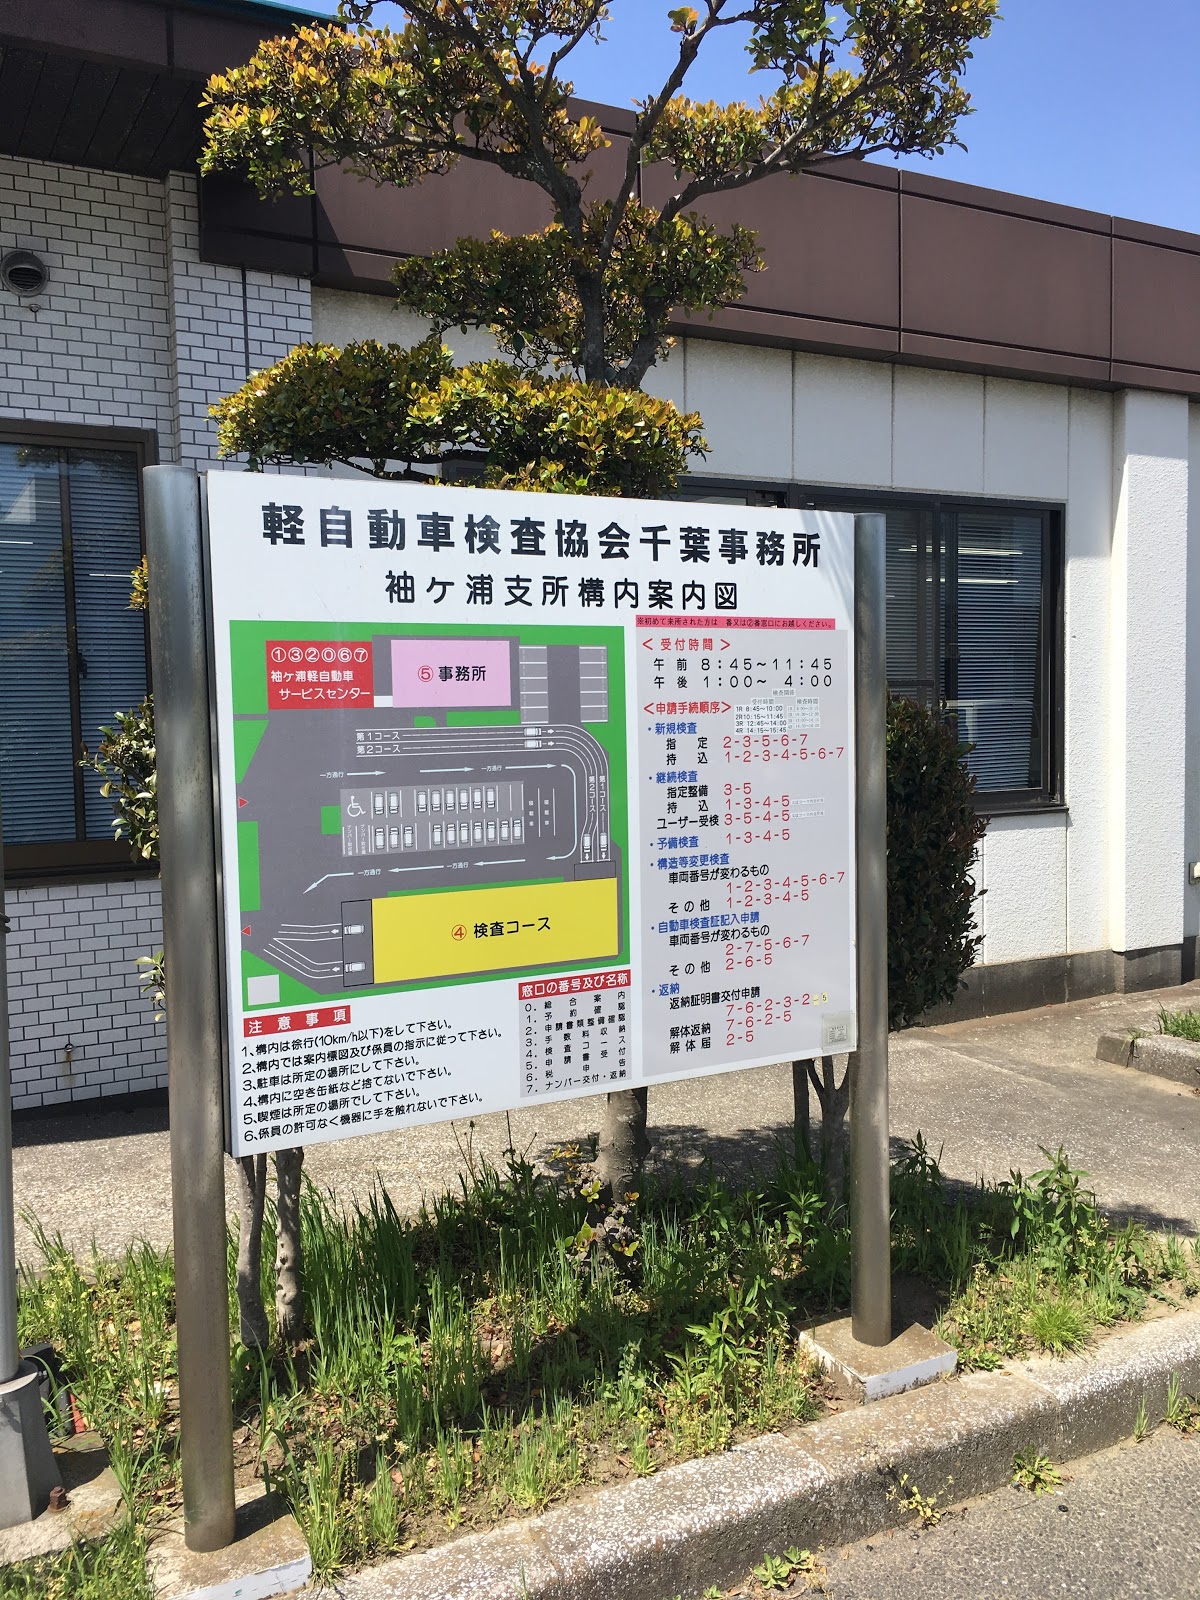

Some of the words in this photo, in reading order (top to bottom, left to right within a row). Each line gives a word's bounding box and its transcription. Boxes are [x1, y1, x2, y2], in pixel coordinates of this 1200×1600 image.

[261, 501, 822, 568] 軽自動車検査協会千葉事務所
[439, 666, 486, 681] 事務所
[654, 658, 688, 670] 午前
[654, 676, 688, 688] 午後
[279, 688, 370, 700] サービスセンター
[356, 731, 401, 742] 第1コース
[356, 743, 401, 754] 第2コース
[726, 747, 844, 763] 1-2-3-4-5-6-7
[667, 785, 708, 798] 指定整備
[724, 783, 751, 795] 3-5
[726, 796, 790, 810] 1-3-4-5
[657, 815, 719, 829] ユーザー受検
[724, 810, 790, 825] 3-5-4-5
[727, 829, 790, 844] 1-3-4-5
[668, 864, 769, 884] 車両番号が変わるもの
[726, 872, 845, 893] 1-2-3-4-5-6-7
[668, 899, 710, 914] その他
[726, 890, 809, 908] 1-2-3-4-5
[474, 916, 551, 938] 検査コース
[669, 925, 769, 946] 車両番号が変わるもの
[725, 935, 809, 955] 2-7-5-6-7
[669, 961, 711, 976] その他
[726, 953, 772, 970] 2-6-5
[522, 973, 628, 997] 窓口の番号及び名称
[670, 987, 760, 1010] 返納証明書交付申請
[249, 1009, 346, 1034] 注意事項
[670, 1023, 711, 1039] 解体返納
[726, 1011, 791, 1031] 7-6-2-5
[670, 1037, 711, 1054] 解体届
[726, 1031, 754, 1045] 2-5
